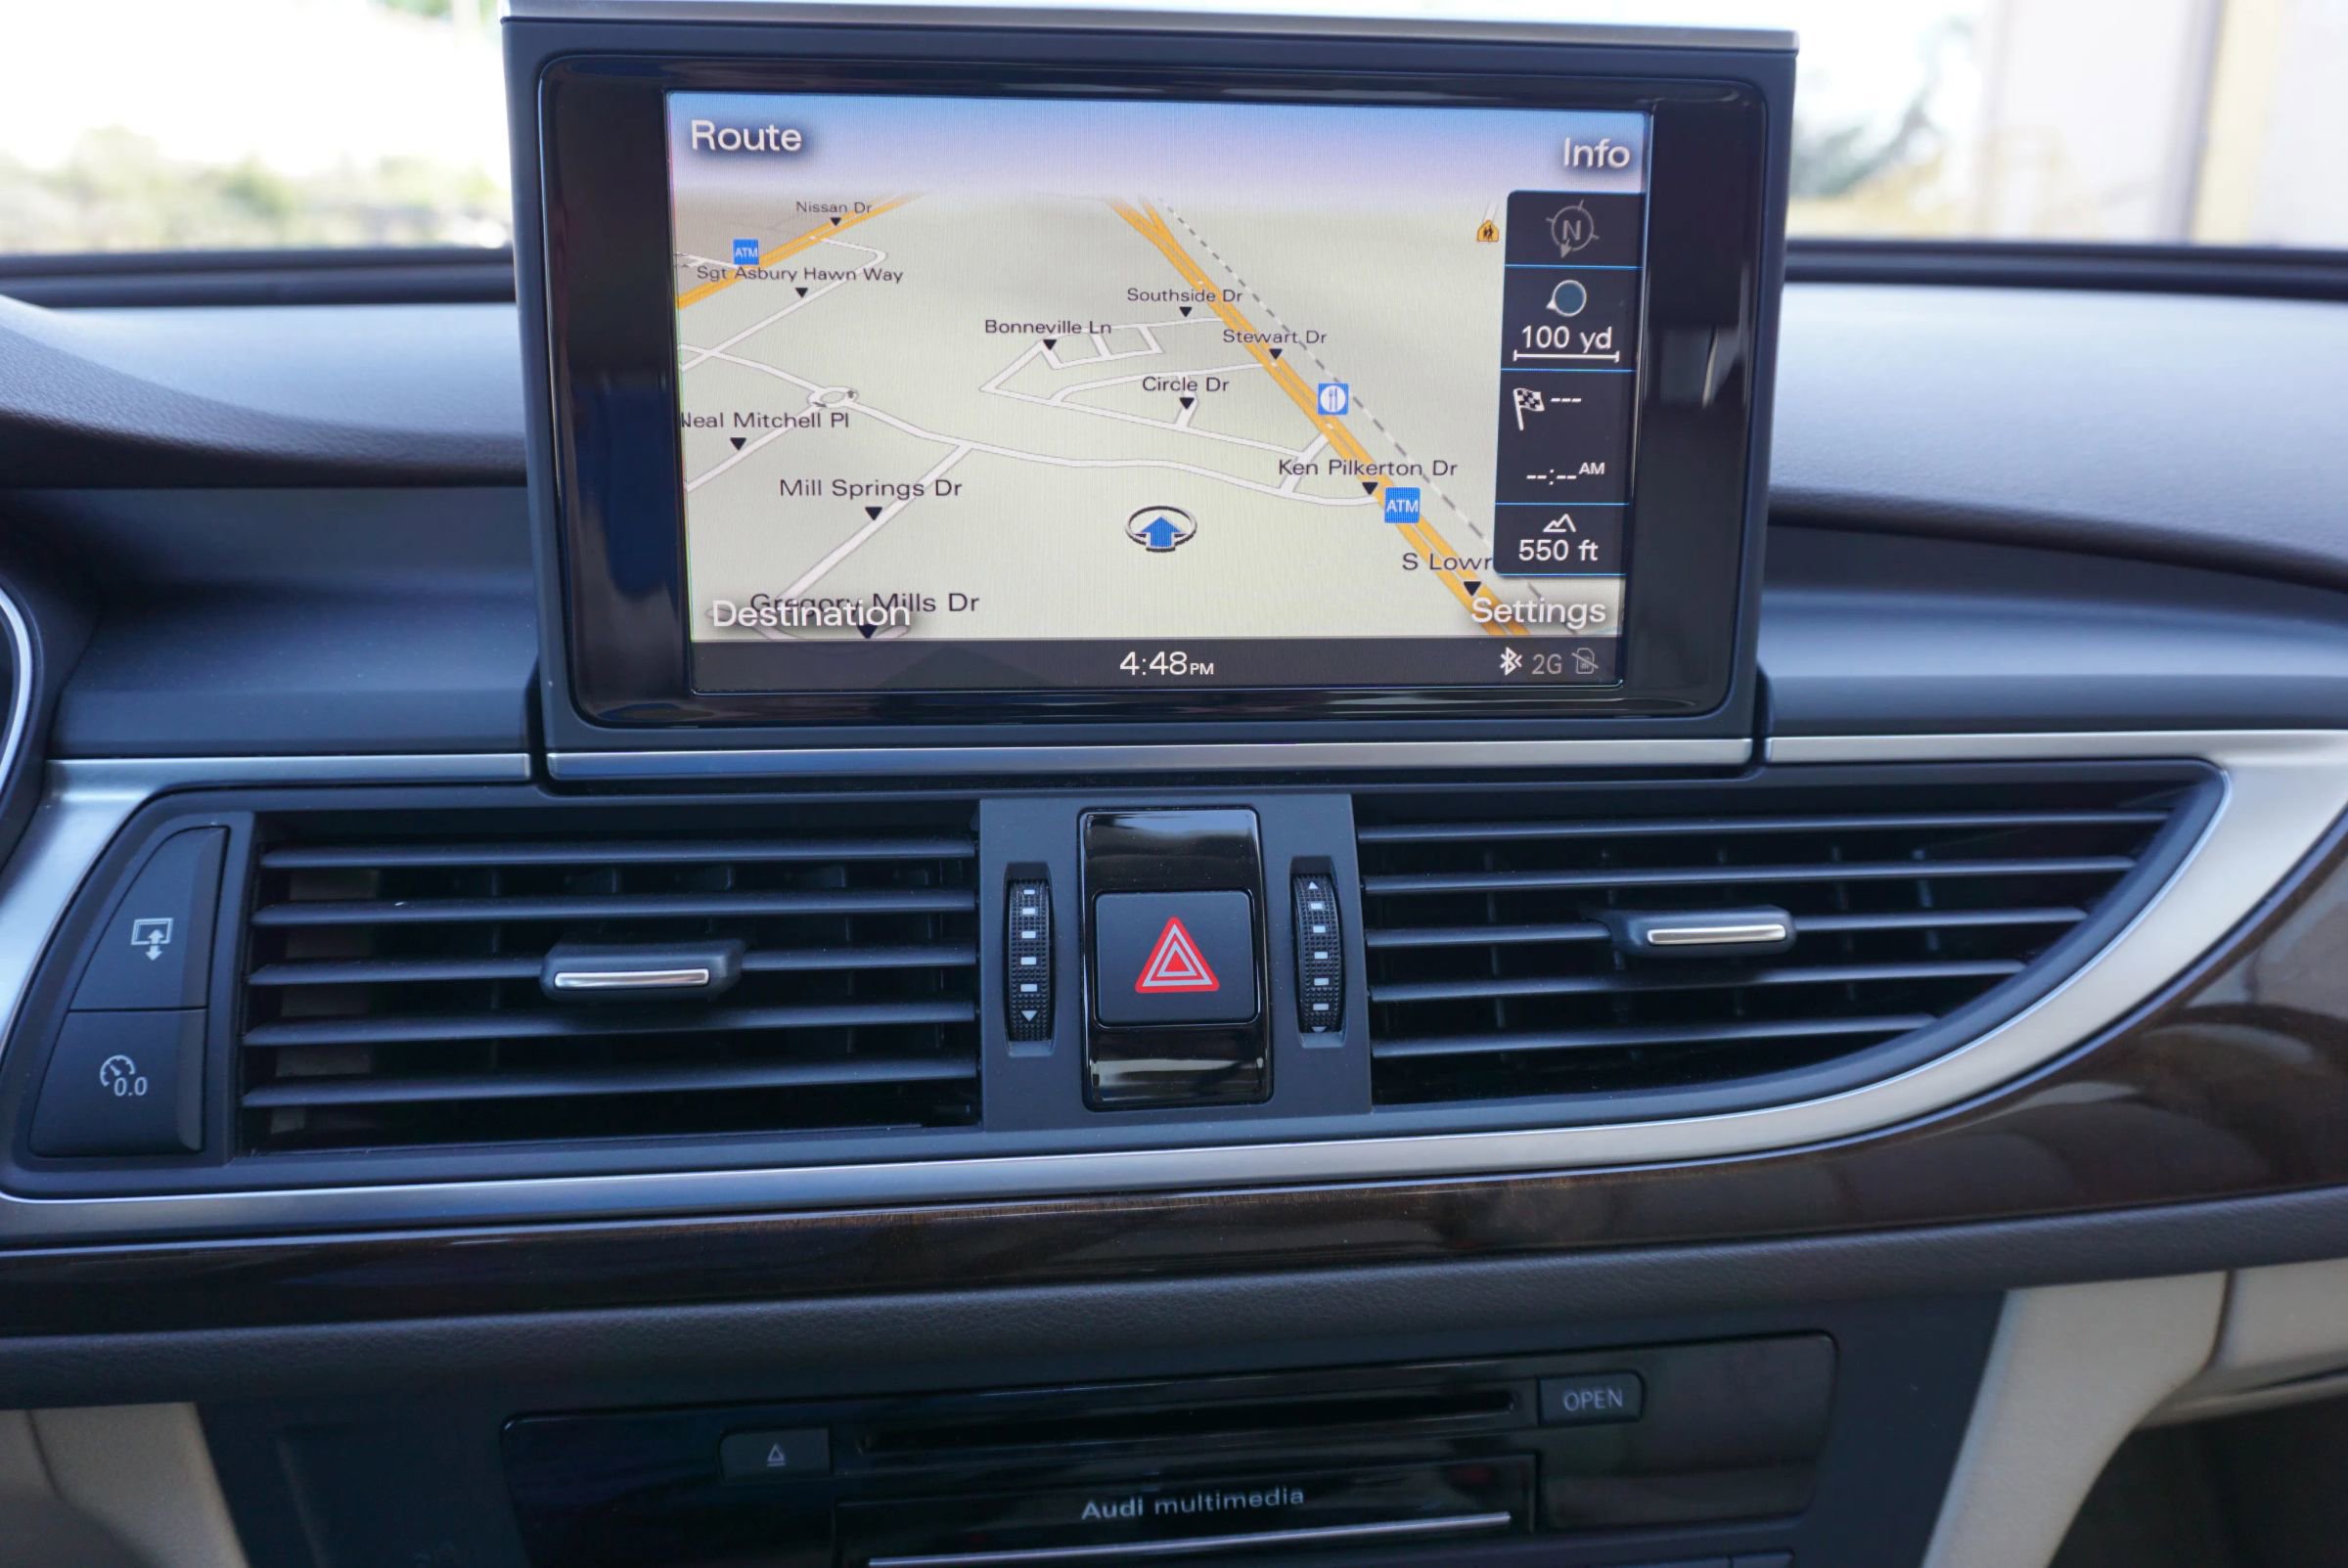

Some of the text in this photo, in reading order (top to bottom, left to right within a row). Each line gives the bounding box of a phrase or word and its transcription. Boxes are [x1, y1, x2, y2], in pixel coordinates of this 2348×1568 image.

[691, 119, 803, 152] Route
[1562, 137, 1631, 168] Info
[795, 201, 873, 214] Nissan Dr
[735, 246, 759, 259] ATM
[696, 265, 904, 283] Sgt Asbury Hawn Way
[1126, 288, 1243, 303] Southside Dr
[984, 319, 1112, 336] Bonneville Ln
[1222, 329, 1328, 344] Stewart Dr
[1521, 325, 1612, 353] 100 yd
[1142, 376, 1230, 392] Circle Dr
[733, 412, 821, 428] Mitchell
[1278, 459, 1458, 476] Ken Pilkerton Dr
[780, 479, 963, 501] Mill Springs Dr
[1385, 500, 1419, 514] ATM
[1518, 539, 1599, 561] 550 ft
[1402, 553, 1419, 571] S
[873, 593, 936, 612] Mills
[948, 593, 979, 612] Dr
[712, 600, 911, 627] Destination
[1470, 597, 1607, 630] Settings
[1531, 653, 1562, 675] 2G
[1563, 1389, 1623, 1411] OPEN
[1081, 1486, 1304, 1520] Audi multimedia
